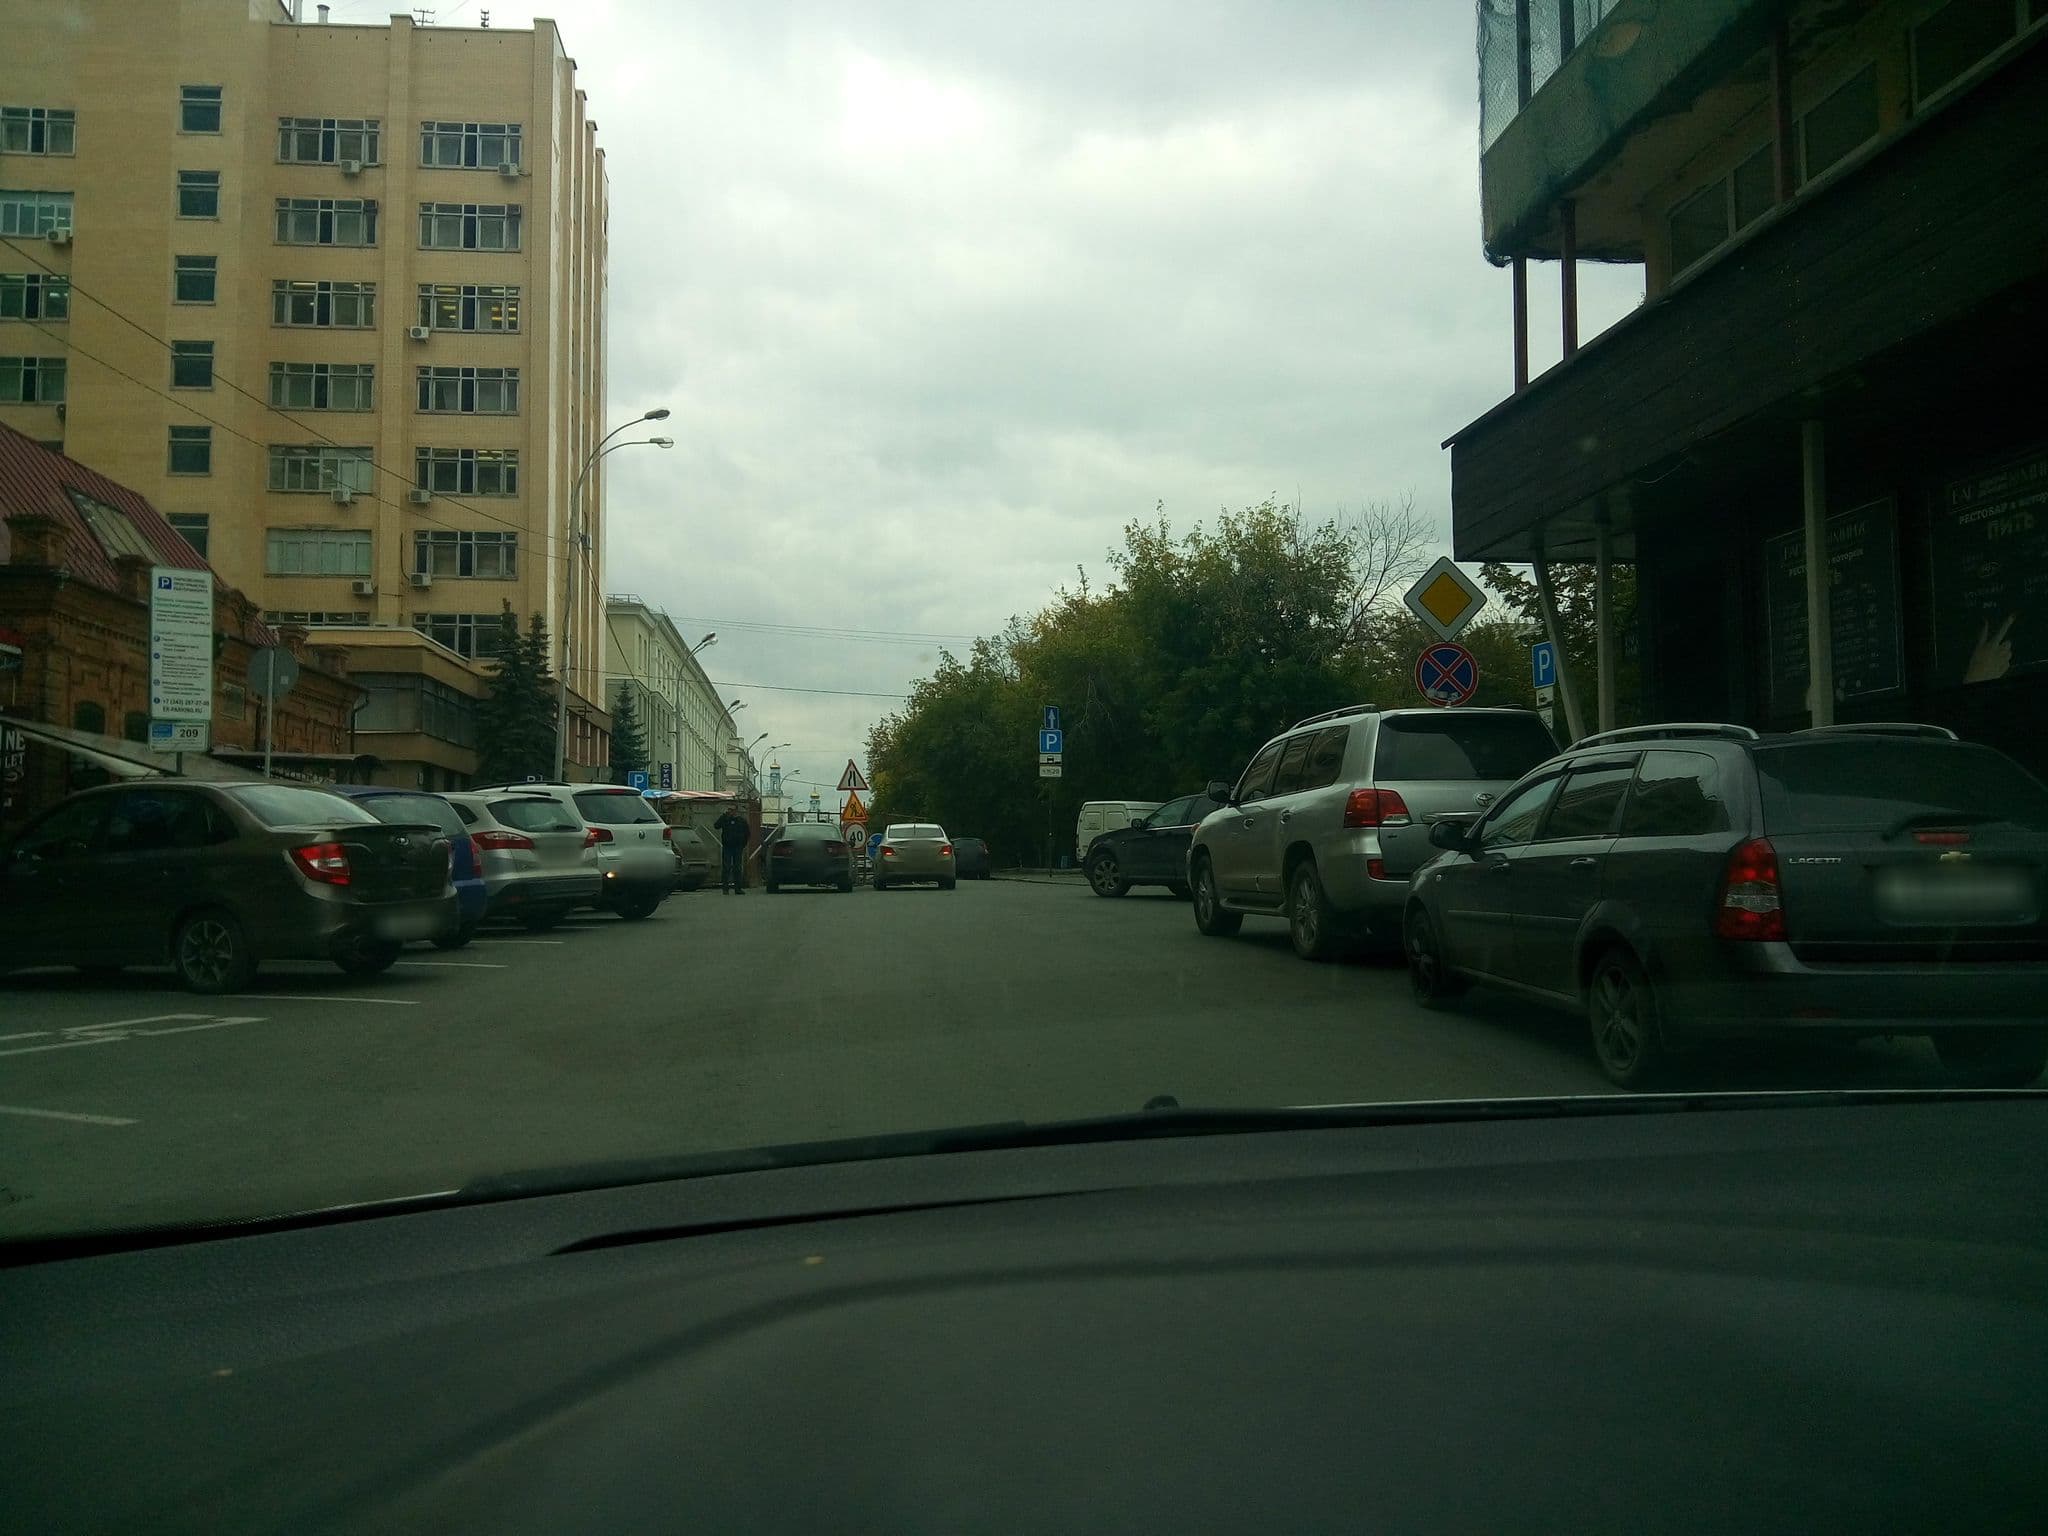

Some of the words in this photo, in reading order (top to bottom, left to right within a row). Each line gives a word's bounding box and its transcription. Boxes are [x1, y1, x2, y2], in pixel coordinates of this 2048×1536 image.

[1539, 649, 1550, 681] P
[180, 729, 199, 738] 209
[1046, 733, 1058, 750] P
[634, 774, 645, 788] P
[849, 831, 863, 843] 40
